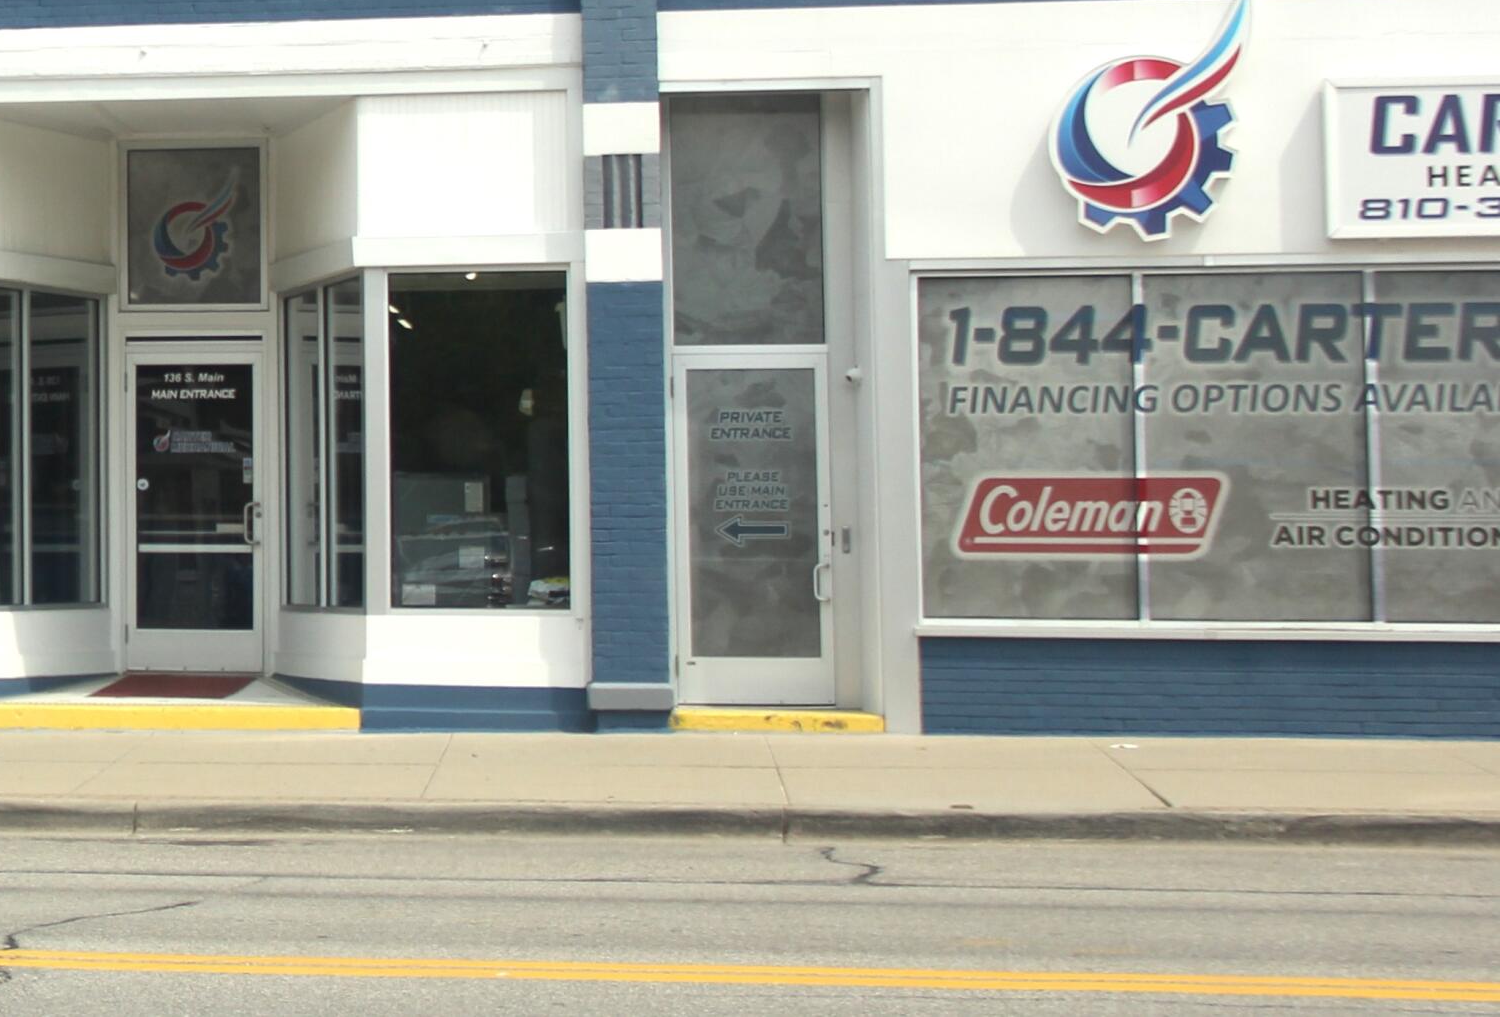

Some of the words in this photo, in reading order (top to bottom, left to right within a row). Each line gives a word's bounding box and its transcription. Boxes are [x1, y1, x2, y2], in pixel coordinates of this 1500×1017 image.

[1426, 164, 1500, 188] HEA
[1358, 196, 1500, 221] 810-3
[948, 301, 1500, 366] 1-844-CARTER
[163, 372, 182, 383] 136
[184, 371, 195, 383] S.
[197, 371, 225, 383] Main
[151, 388, 178, 400] MAIN
[179, 388, 237, 400] ENTRANCE
[948, 383, 1159, 415] FINANCING
[1170, 383, 1343, 414] OPTIONS
[1352, 382, 1500, 413] AVAILA
[719, 410, 784, 423] PRIVATE
[710, 426, 792, 440] ENTRANCE
[726, 470, 780, 483] PLEASE
[718, 484, 747, 497] USE
[750, 484, 786, 496] MAIN
[714, 498, 789, 510] ENTRANCE
[1309, 489, 1450, 511] HEATING
[979, 484, 1164, 535] Coleman
[1272, 525, 1327, 546] AIR
